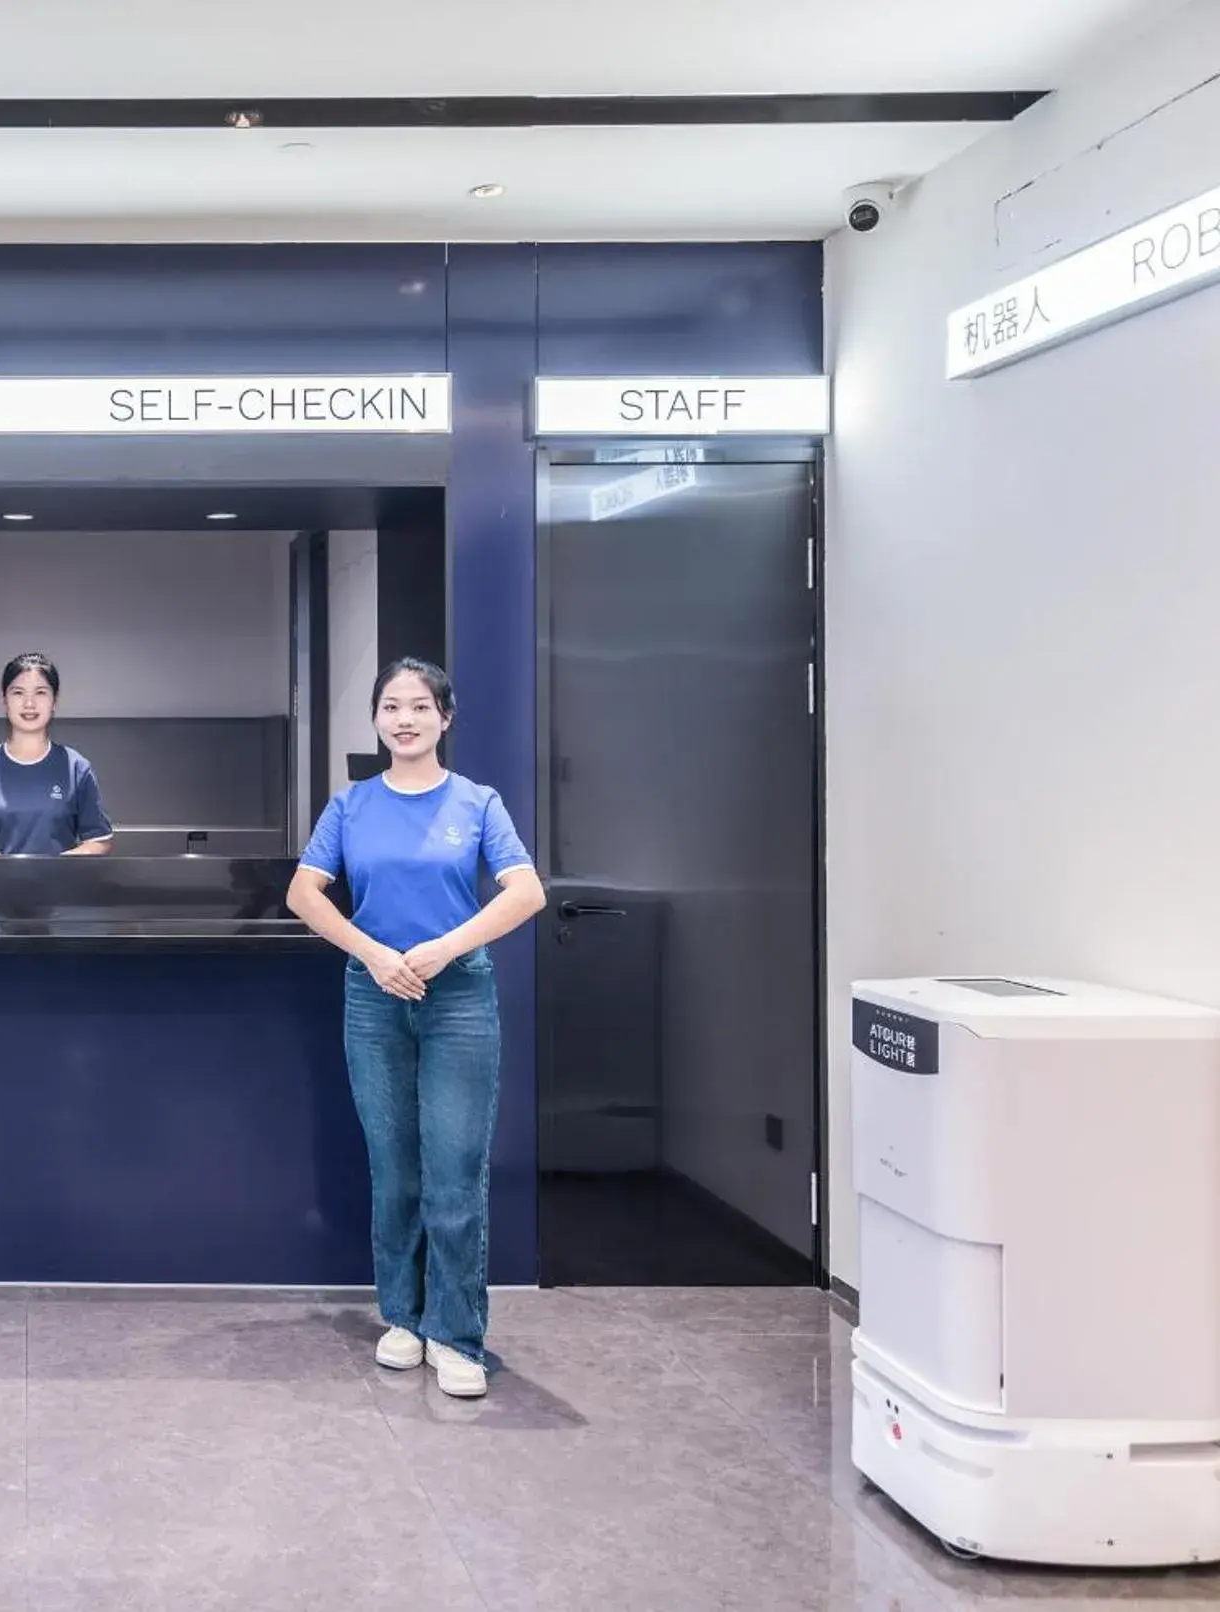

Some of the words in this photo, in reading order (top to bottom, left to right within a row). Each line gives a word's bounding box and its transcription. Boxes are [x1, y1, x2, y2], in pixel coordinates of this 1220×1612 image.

[1133, 208, 1220, 284] ROB
[964, 286, 1050, 356] 机器人
[109, 387, 426, 421] SELF-CHECKIN
[620, 389, 746, 421] STAFF
[869, 1023, 907, 1048] ATOUR
[869, 1039, 906, 1064] LIGHT
